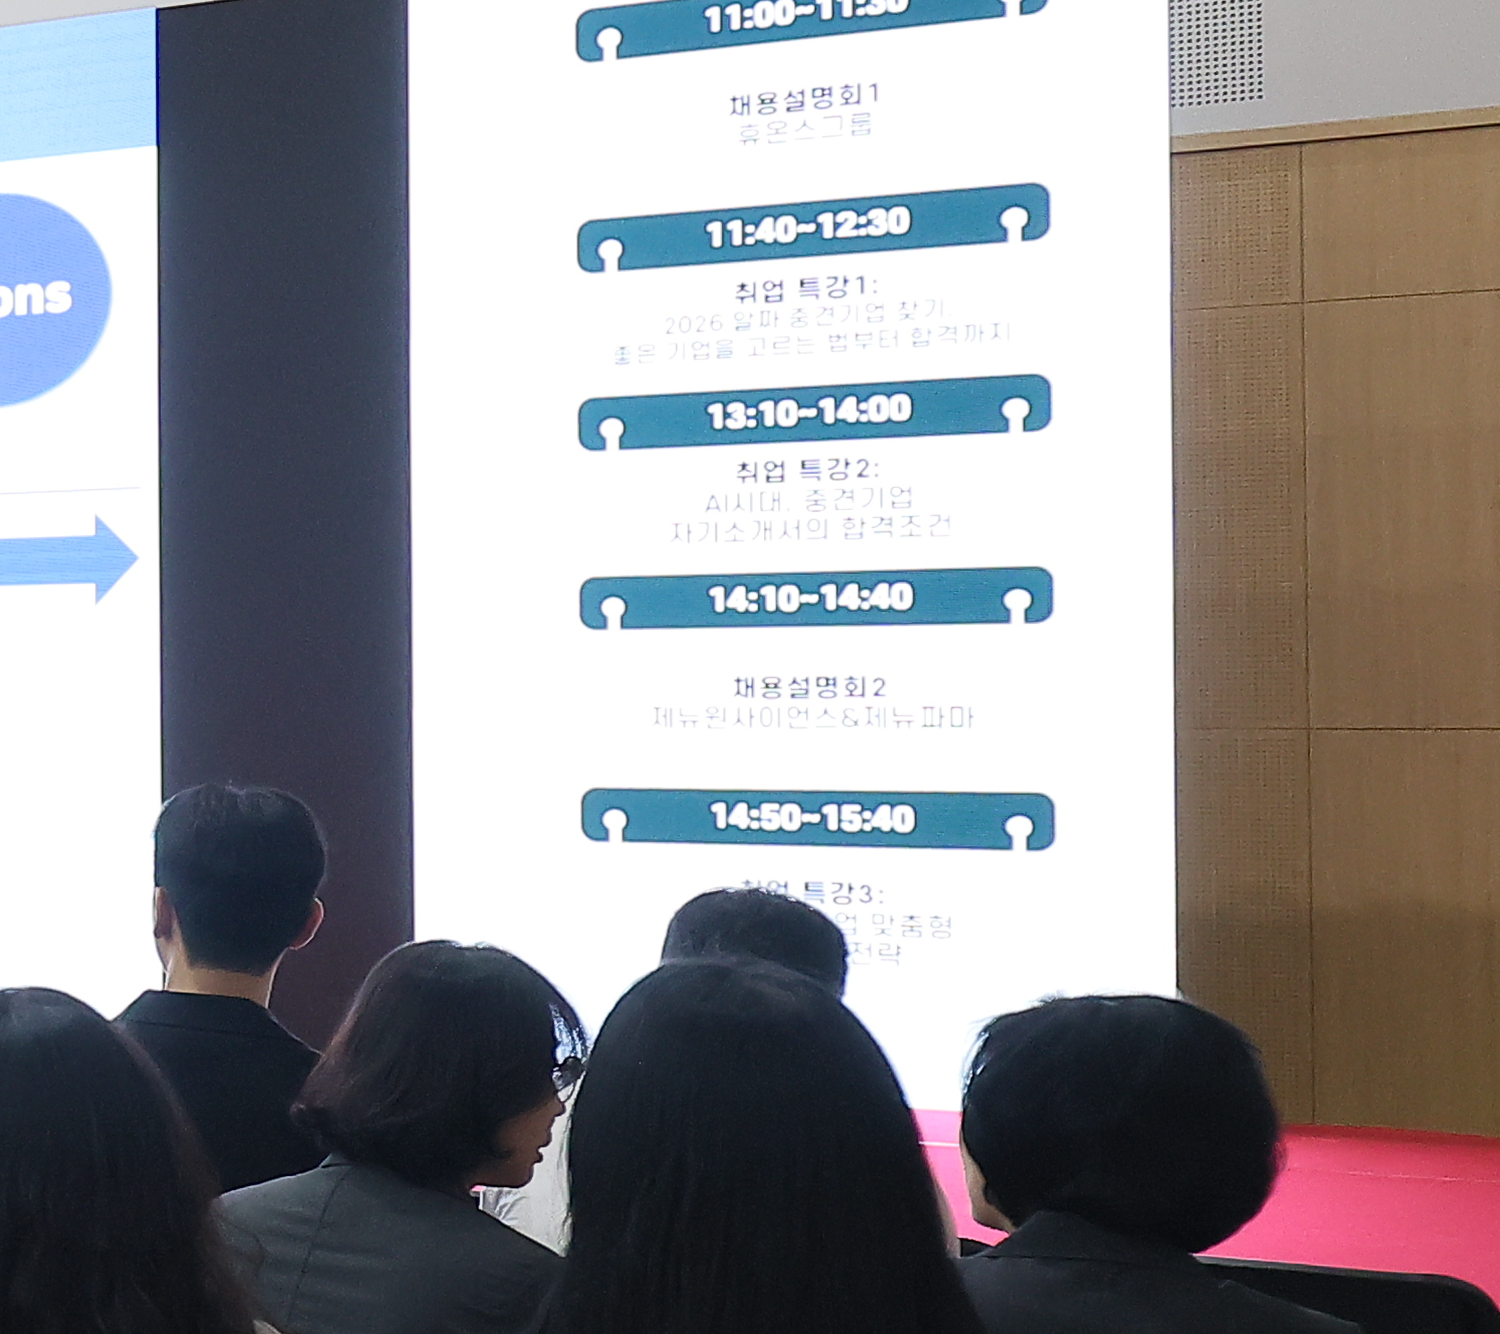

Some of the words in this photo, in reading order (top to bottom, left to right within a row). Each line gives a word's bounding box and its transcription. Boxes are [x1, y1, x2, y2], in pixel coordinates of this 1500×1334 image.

[728, 81, 881, 118] 채용설명회1
[738, 112, 874, 147] 휴온스그룹
[707, 207, 910, 247] 11:40~12:30
[734, 278, 785, 305] 취업
[797, 274, 880, 300] 특강1:
[664, 315, 724, 335] 2026
[732, 310, 779, 333] 알파
[789, 301, 885, 328] 중견기업
[613, 342, 656, 366] 좋은
[669, 338, 734, 362] 기업을
[748, 336, 816, 358] 고르는
[828, 329, 900, 353] 법부터
[910, 321, 1011, 347] 합격까지
[708, 394, 911, 429] 13:10~14:00
[735, 458, 786, 485] 취업
[799, 457, 880, 482] 특강2:
[804, 485, 914, 512] 중견기업
[670, 518, 829, 544] 자기소개서의
[842, 513, 952, 541] 합격조건
[708, 582, 916, 615] 14:10~14:40
[733, 674, 888, 700] 채용설명회2
[711, 803, 915, 833] 14:50~15:40
[871, 912, 953, 940] 맞춤형
